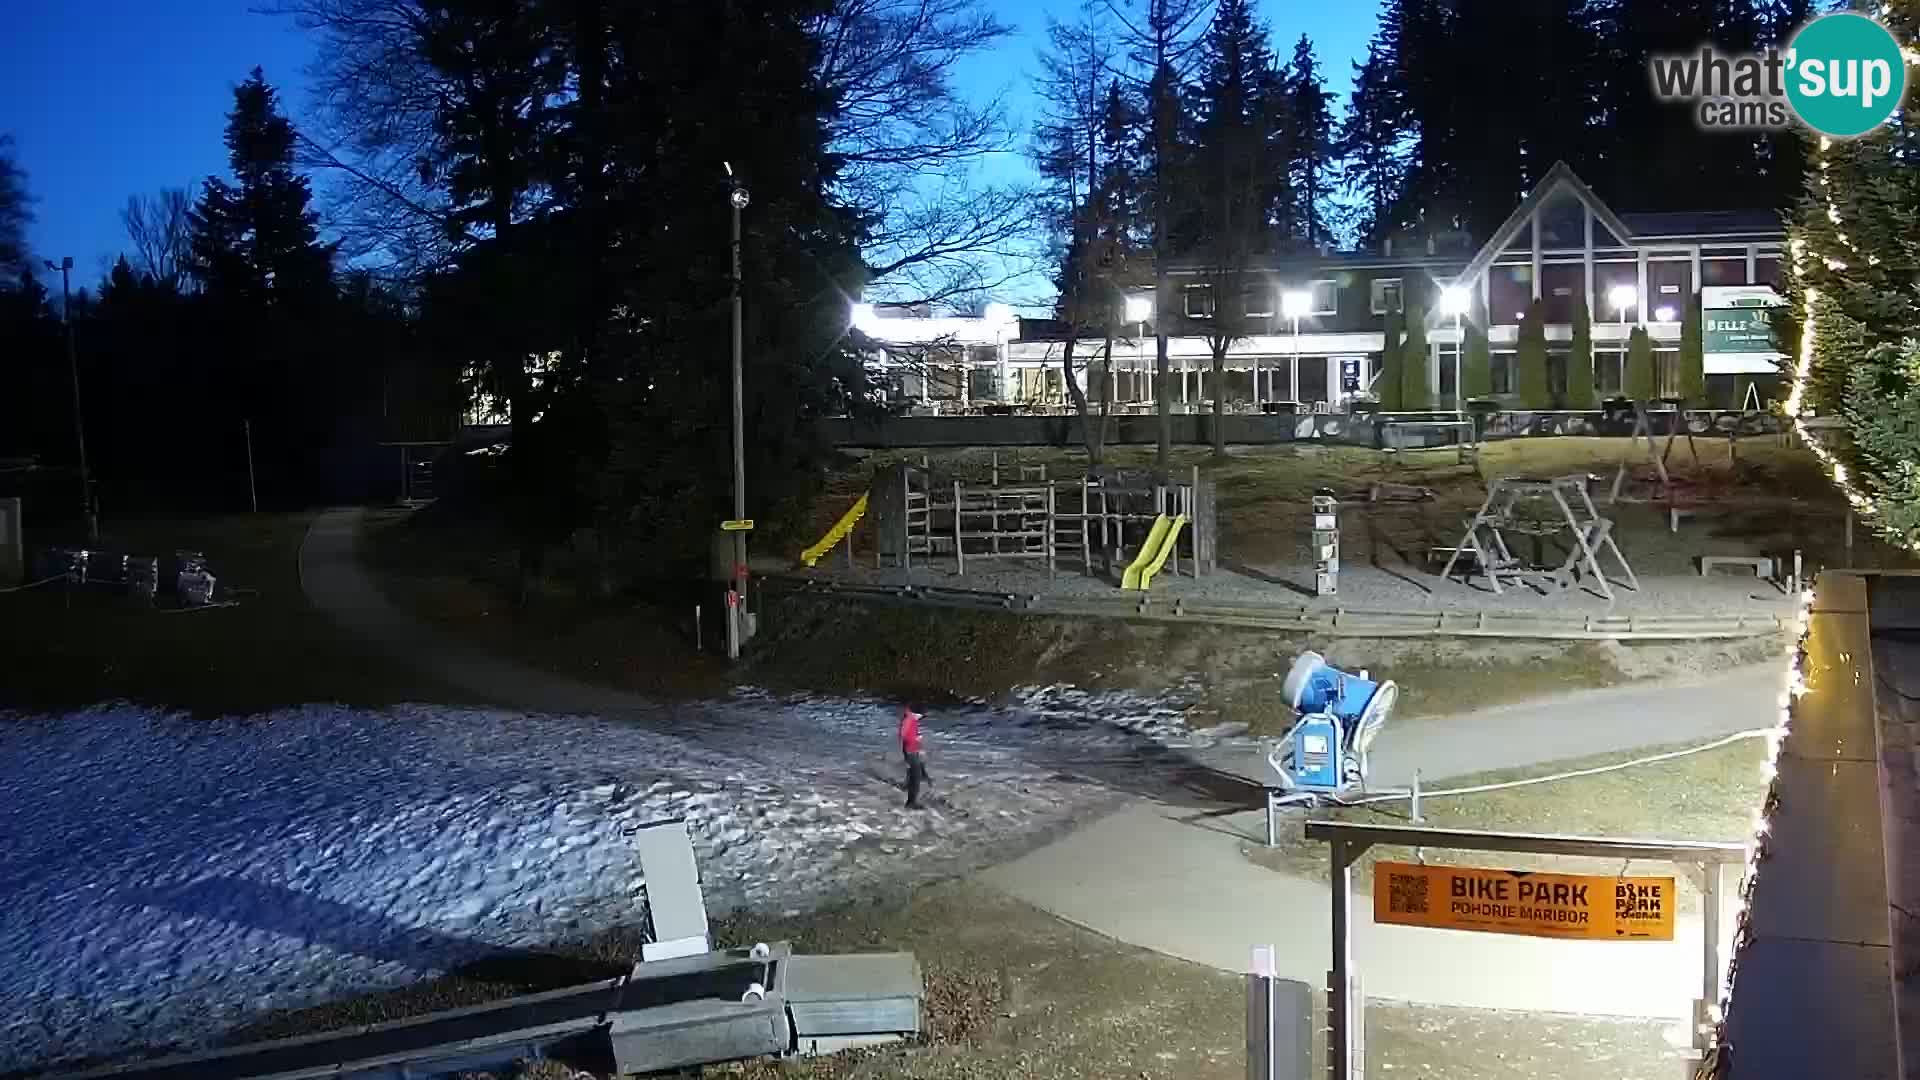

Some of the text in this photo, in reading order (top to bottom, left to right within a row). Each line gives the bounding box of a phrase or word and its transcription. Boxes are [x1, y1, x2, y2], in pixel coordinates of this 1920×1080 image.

[1451, 876, 1588, 906] BIKE PARK
[1520, 905, 1588, 924] MARIBOR
